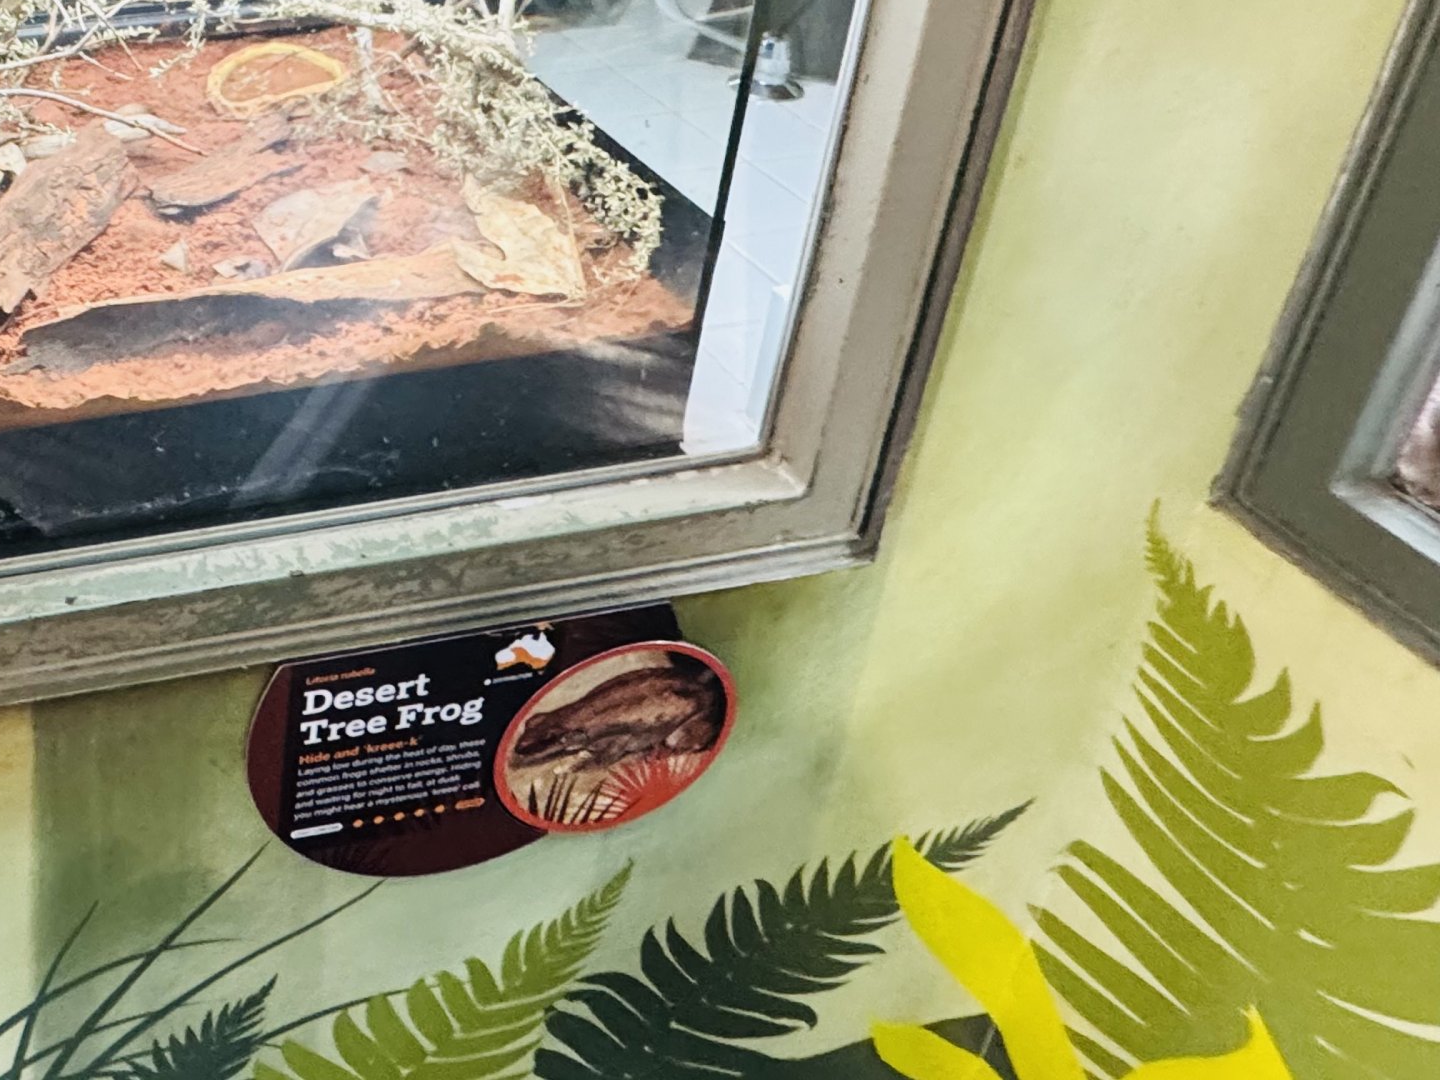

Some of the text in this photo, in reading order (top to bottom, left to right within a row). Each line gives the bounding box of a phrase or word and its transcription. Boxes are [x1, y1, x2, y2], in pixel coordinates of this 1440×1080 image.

[302, 673, 430, 716] Desert
[300, 697, 485, 745] Tree Frog
[299, 752, 330, 765] Hide
[334, 746, 359, 759] and
[332, 762, 350, 771] low
[352, 757, 383, 767] during
[385, 754, 401, 762] the
[403, 749, 425, 758] heat
[426, 745, 437, 754] of
[459, 739, 486, 749] these
[296, 775, 340, 787] common
[342, 770, 368, 780] frogs
[369, 764, 401, 775] shelter
[296, 789, 315, 798] and
[316, 783, 355, 795] grasses
[369, 773, 413, 786] conserve
[295, 800, 314, 810] and
[315, 795, 351, 805] waiting
[353, 791, 367, 799] for
[368, 786, 393, 796] night
[395, 784, 405, 792] to
[426, 779, 436, 787] at
[437, 774, 460, 784] dusk
[294, 813, 312, 822] you
[314, 806, 342, 816] might
[343, 802, 365, 811] hear
